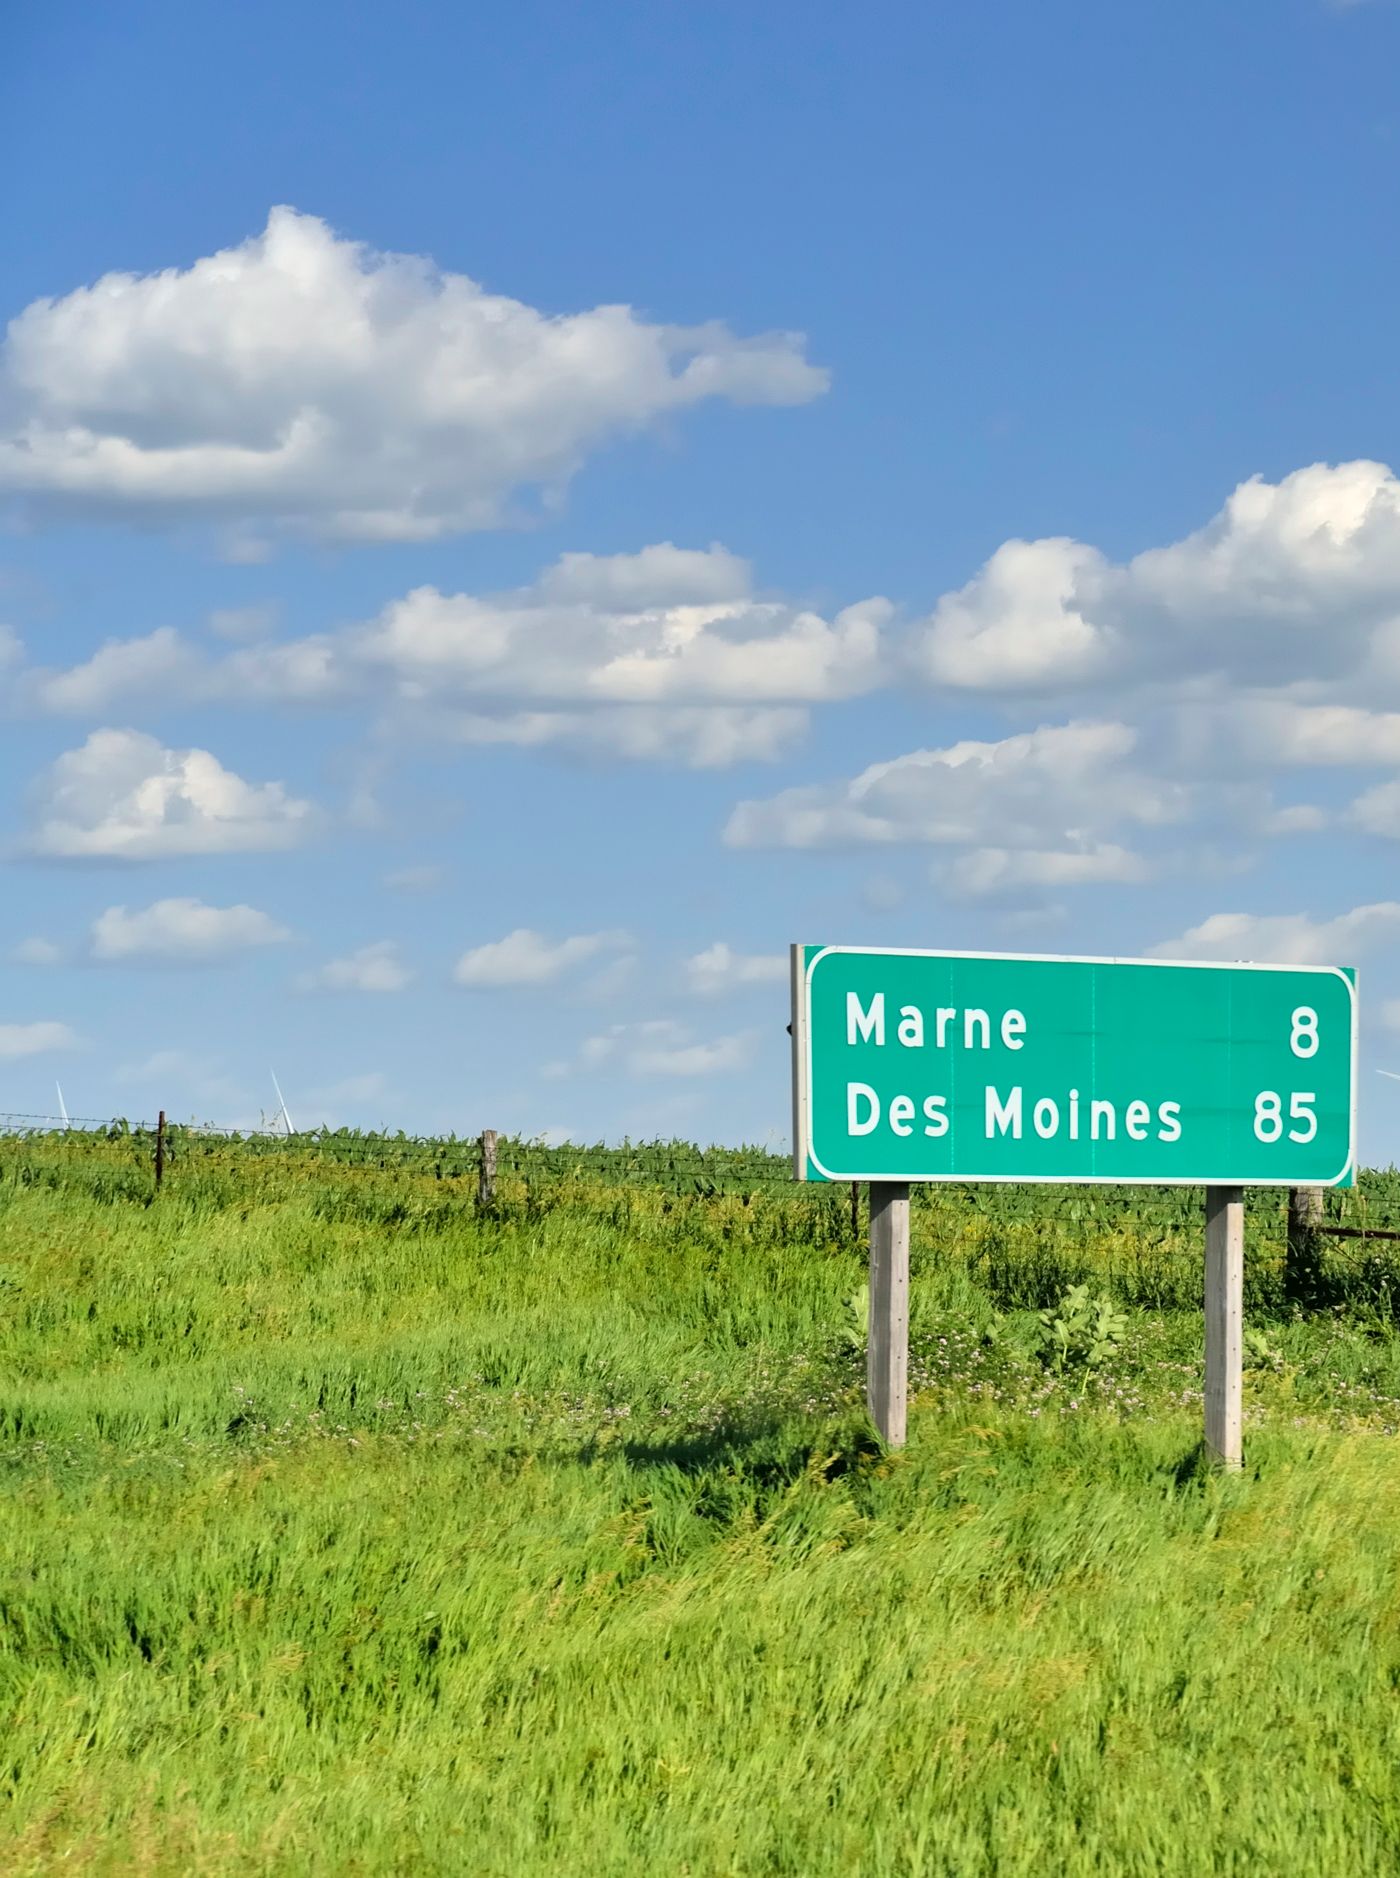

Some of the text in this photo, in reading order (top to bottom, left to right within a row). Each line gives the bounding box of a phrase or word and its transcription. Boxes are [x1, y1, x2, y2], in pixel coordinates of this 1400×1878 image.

[846, 991, 1319, 1059] Marne 8
[847, 1082, 1318, 1144] Des Moines 85
